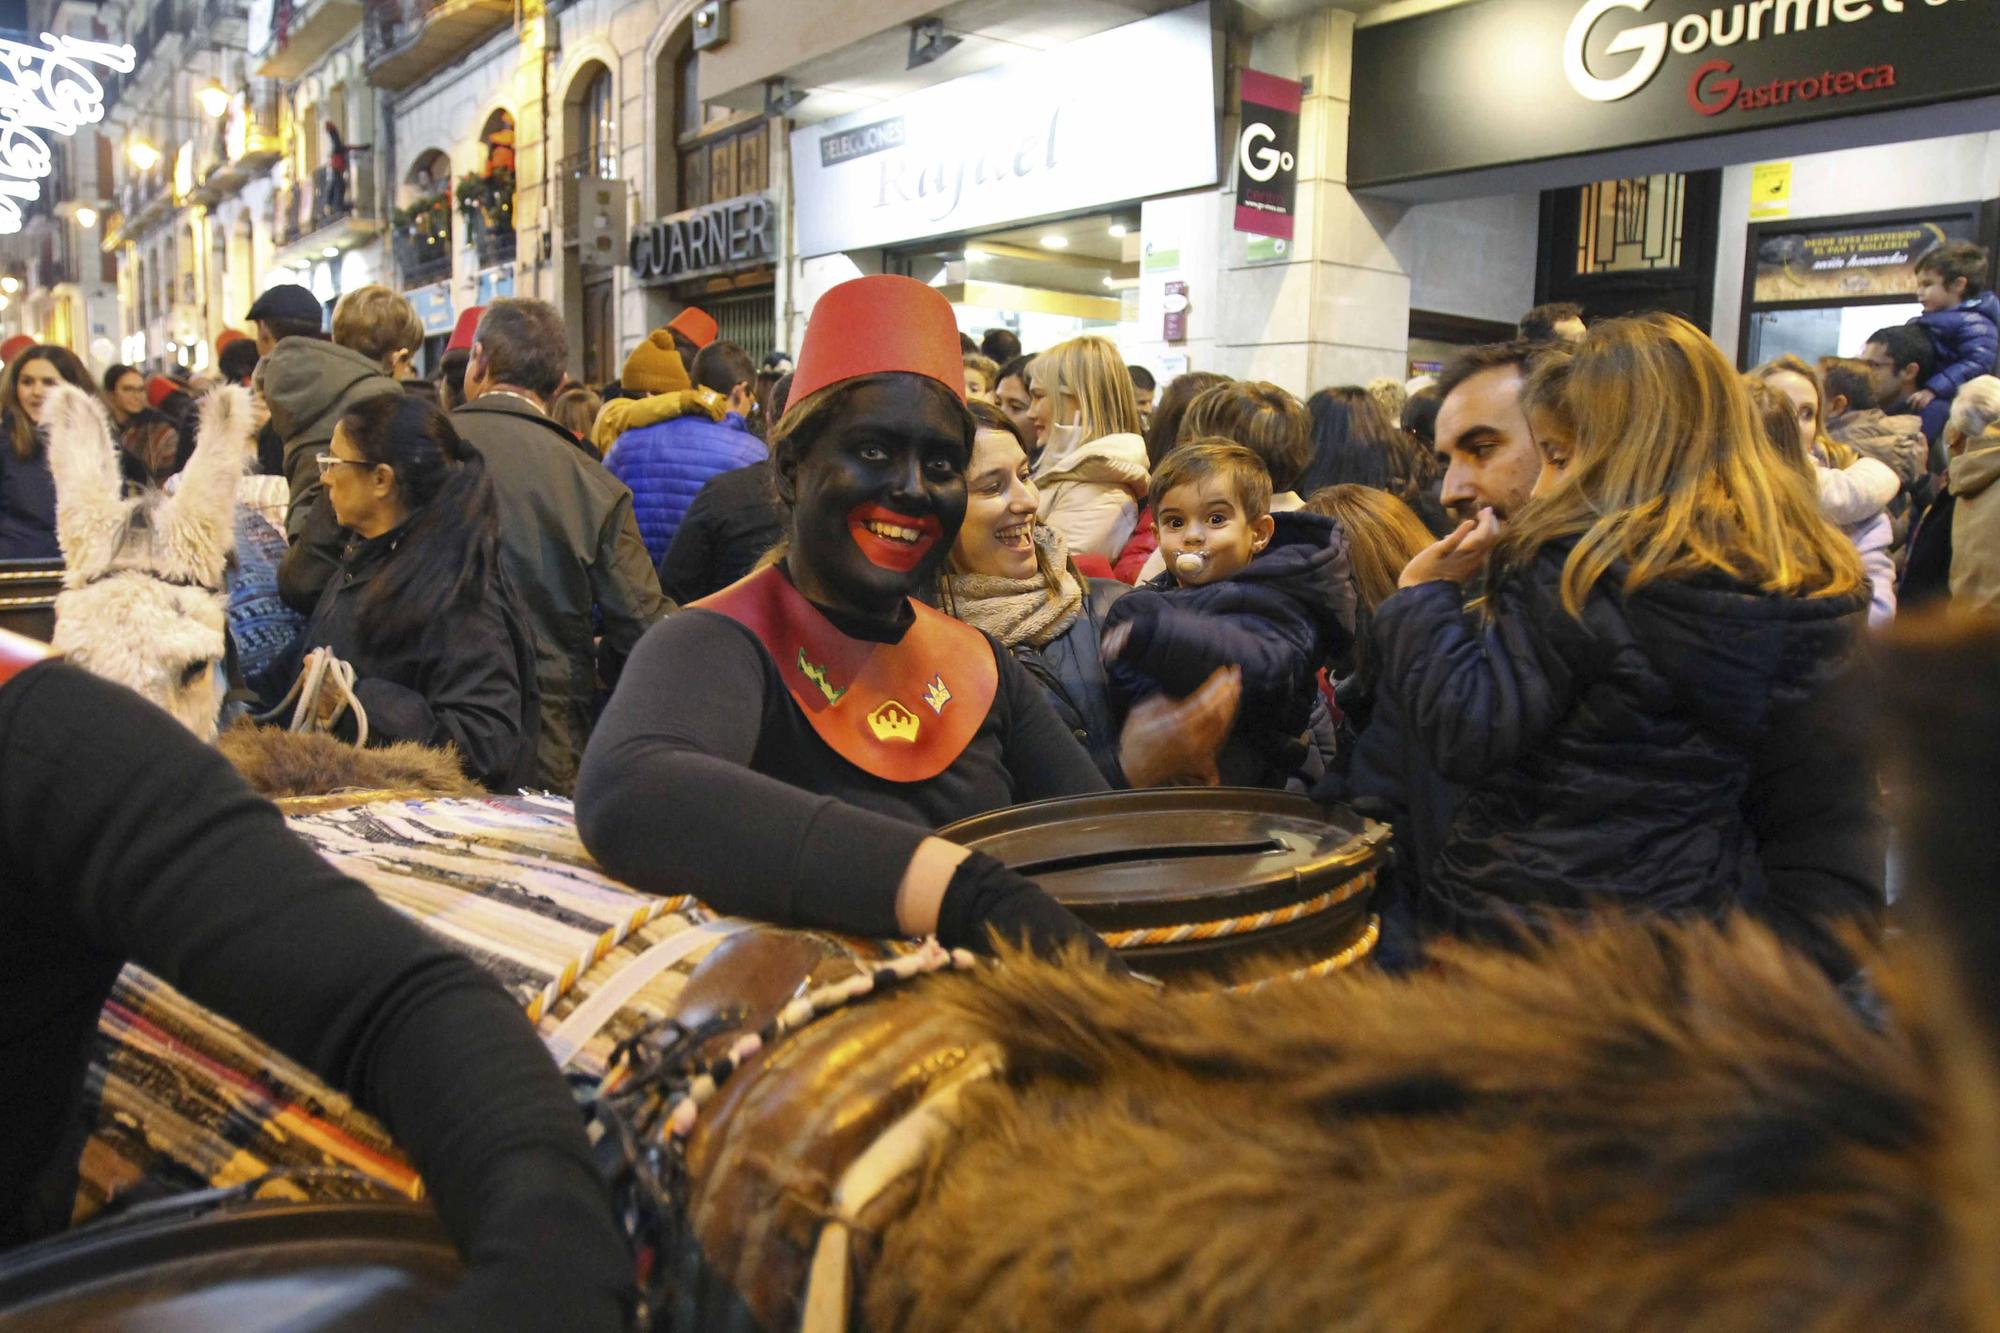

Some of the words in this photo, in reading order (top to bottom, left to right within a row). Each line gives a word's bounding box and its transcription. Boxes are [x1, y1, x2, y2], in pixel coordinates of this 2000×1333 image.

[1563, 0, 1905, 102] Gourme
[1687, 59, 1896, 116] Gastroteca
[1240, 122, 1294, 182] Go
[630, 199, 769, 279] GUARNER
